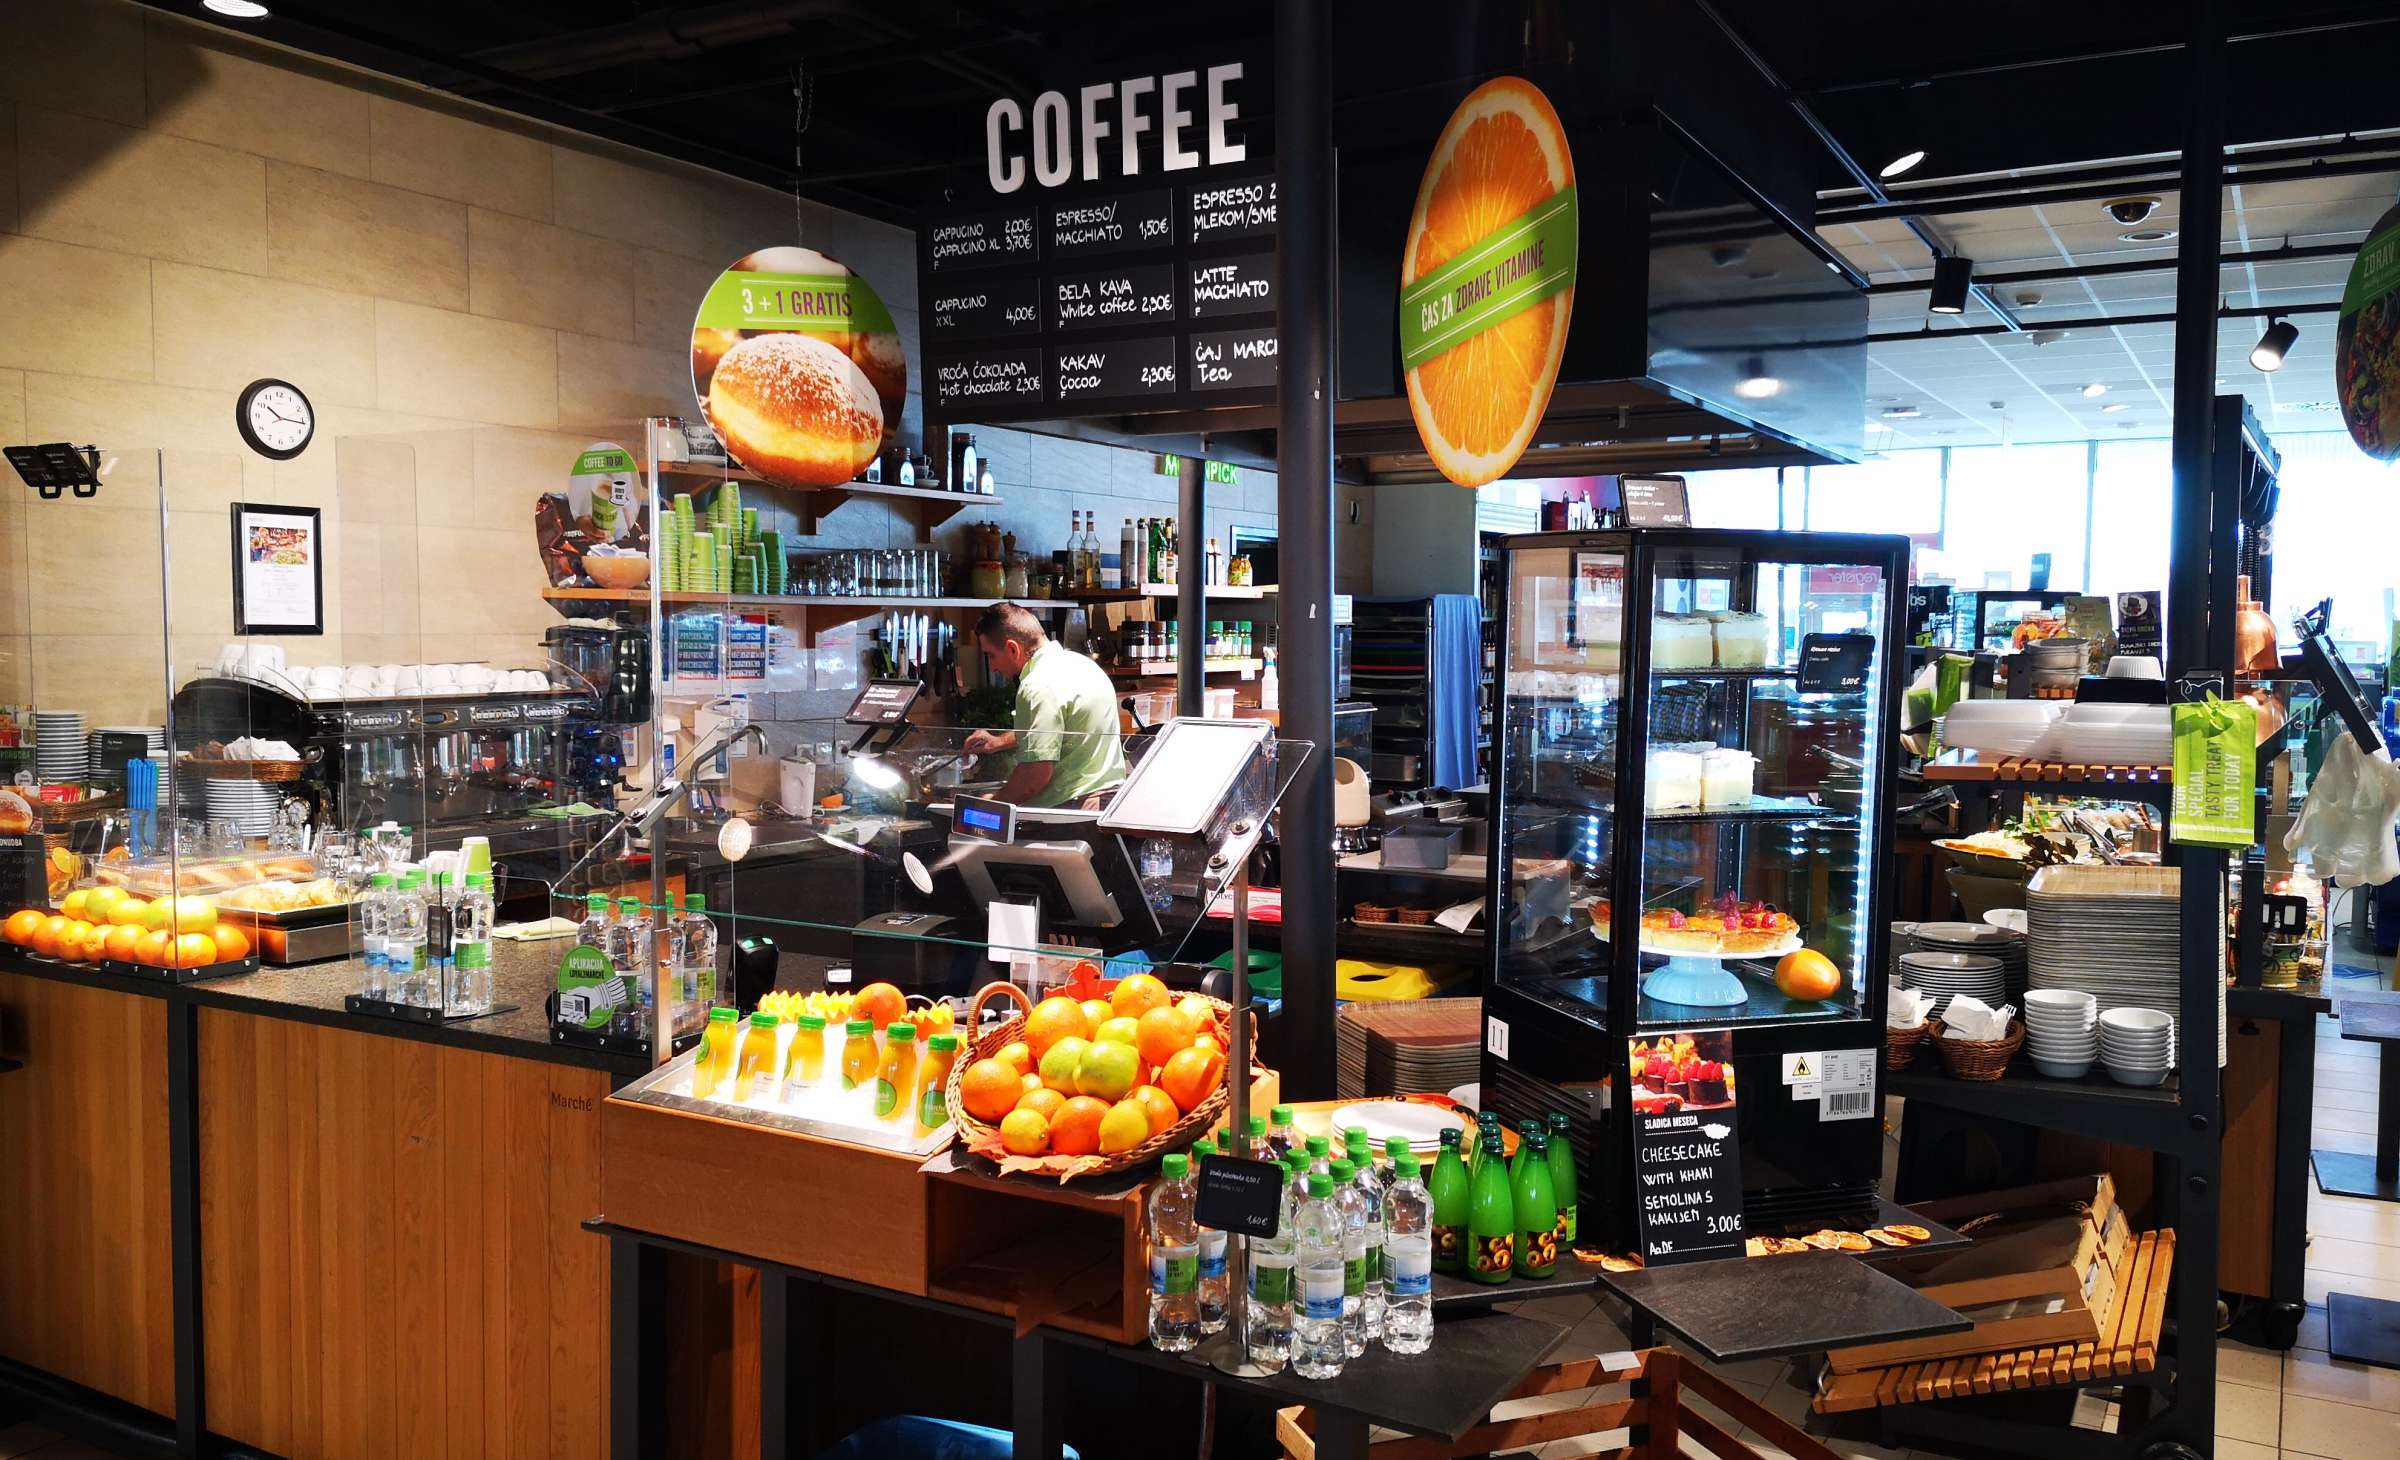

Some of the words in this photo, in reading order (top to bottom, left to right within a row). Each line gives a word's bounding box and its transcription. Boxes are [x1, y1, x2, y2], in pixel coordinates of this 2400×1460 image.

[986, 62, 1246, 194] COFFEE
[1194, 185, 1263, 211] ESPRESSO
[1056, 201, 1117, 227] ESPRESSO/
[933, 223, 984, 243] CAPPUCINO
[1005, 218, 1032, 237] 2,00€
[1056, 224, 1122, 246] MACCHIATO
[1139, 218, 1169, 240] 1,50€
[1194, 232, 1200, 243] F
[933, 238, 987, 258] CAPPUCINO
[989, 238, 1001, 251] XL
[1005, 233, 1033, 253] 3,70€
[1194, 265, 1238, 284] LATTE
[1059, 283, 1091, 301] BELA
[1100, 279, 1133, 297] KAVA
[1194, 280, 1269, 303] MACCHIATO
[1421, 300, 1439, 333] ČAS
[1441, 292, 1454, 321] ZA
[1456, 270, 1492, 313] ZDRAVE
[1495, 239, 1545, 290] VITAMINE
[742, 287, 754, 315] 3
[759, 296, 772, 312] +
[776, 289, 784, 315] 1
[791, 289, 853, 317] GRATIS
[935, 295, 987, 312] CAPPUCINO
[1060, 302, 1096, 319] White
[1100, 296, 1138, 314] coffee
[1195, 306, 1201, 317] F
[936, 315, 956, 328] XXL
[1006, 306, 1036, 327] 4,00€
[1233, 338, 1278, 360] MARC
[1060, 354, 1106, 371] KAKAV
[1197, 363, 1233, 384] Tea
[940, 379, 961, 397] Hot
[963, 378, 1012, 397] chocolate
[1060, 375, 1102, 390] Cocoa
[1141, 365, 1176, 388] 2,30€
[583, 456, 605, 468] COFFEE
[605, 455, 614, 467] TO
[2207, 738, 2223, 778] TREAT
[2223, 753, 2241, 792] TODAY
[2188, 769, 2204, 817] SPECIAL
[2205, 782, 2221, 818] TASTY
[2224, 796, 2241, 819] FOR
[1644, 1118, 1672, 1130] SLADICA
[1672, 1115, 1699, 1127] MESECA
[1642, 1142, 1723, 1163] CHEESECAKE
[1642, 1172, 1675, 1186] WITH
[1679, 1166, 1713, 1183] KHAKI
[1644, 1191, 1702, 1210] SEMOLINA
[1706, 1214, 1742, 1234] 3.00€
